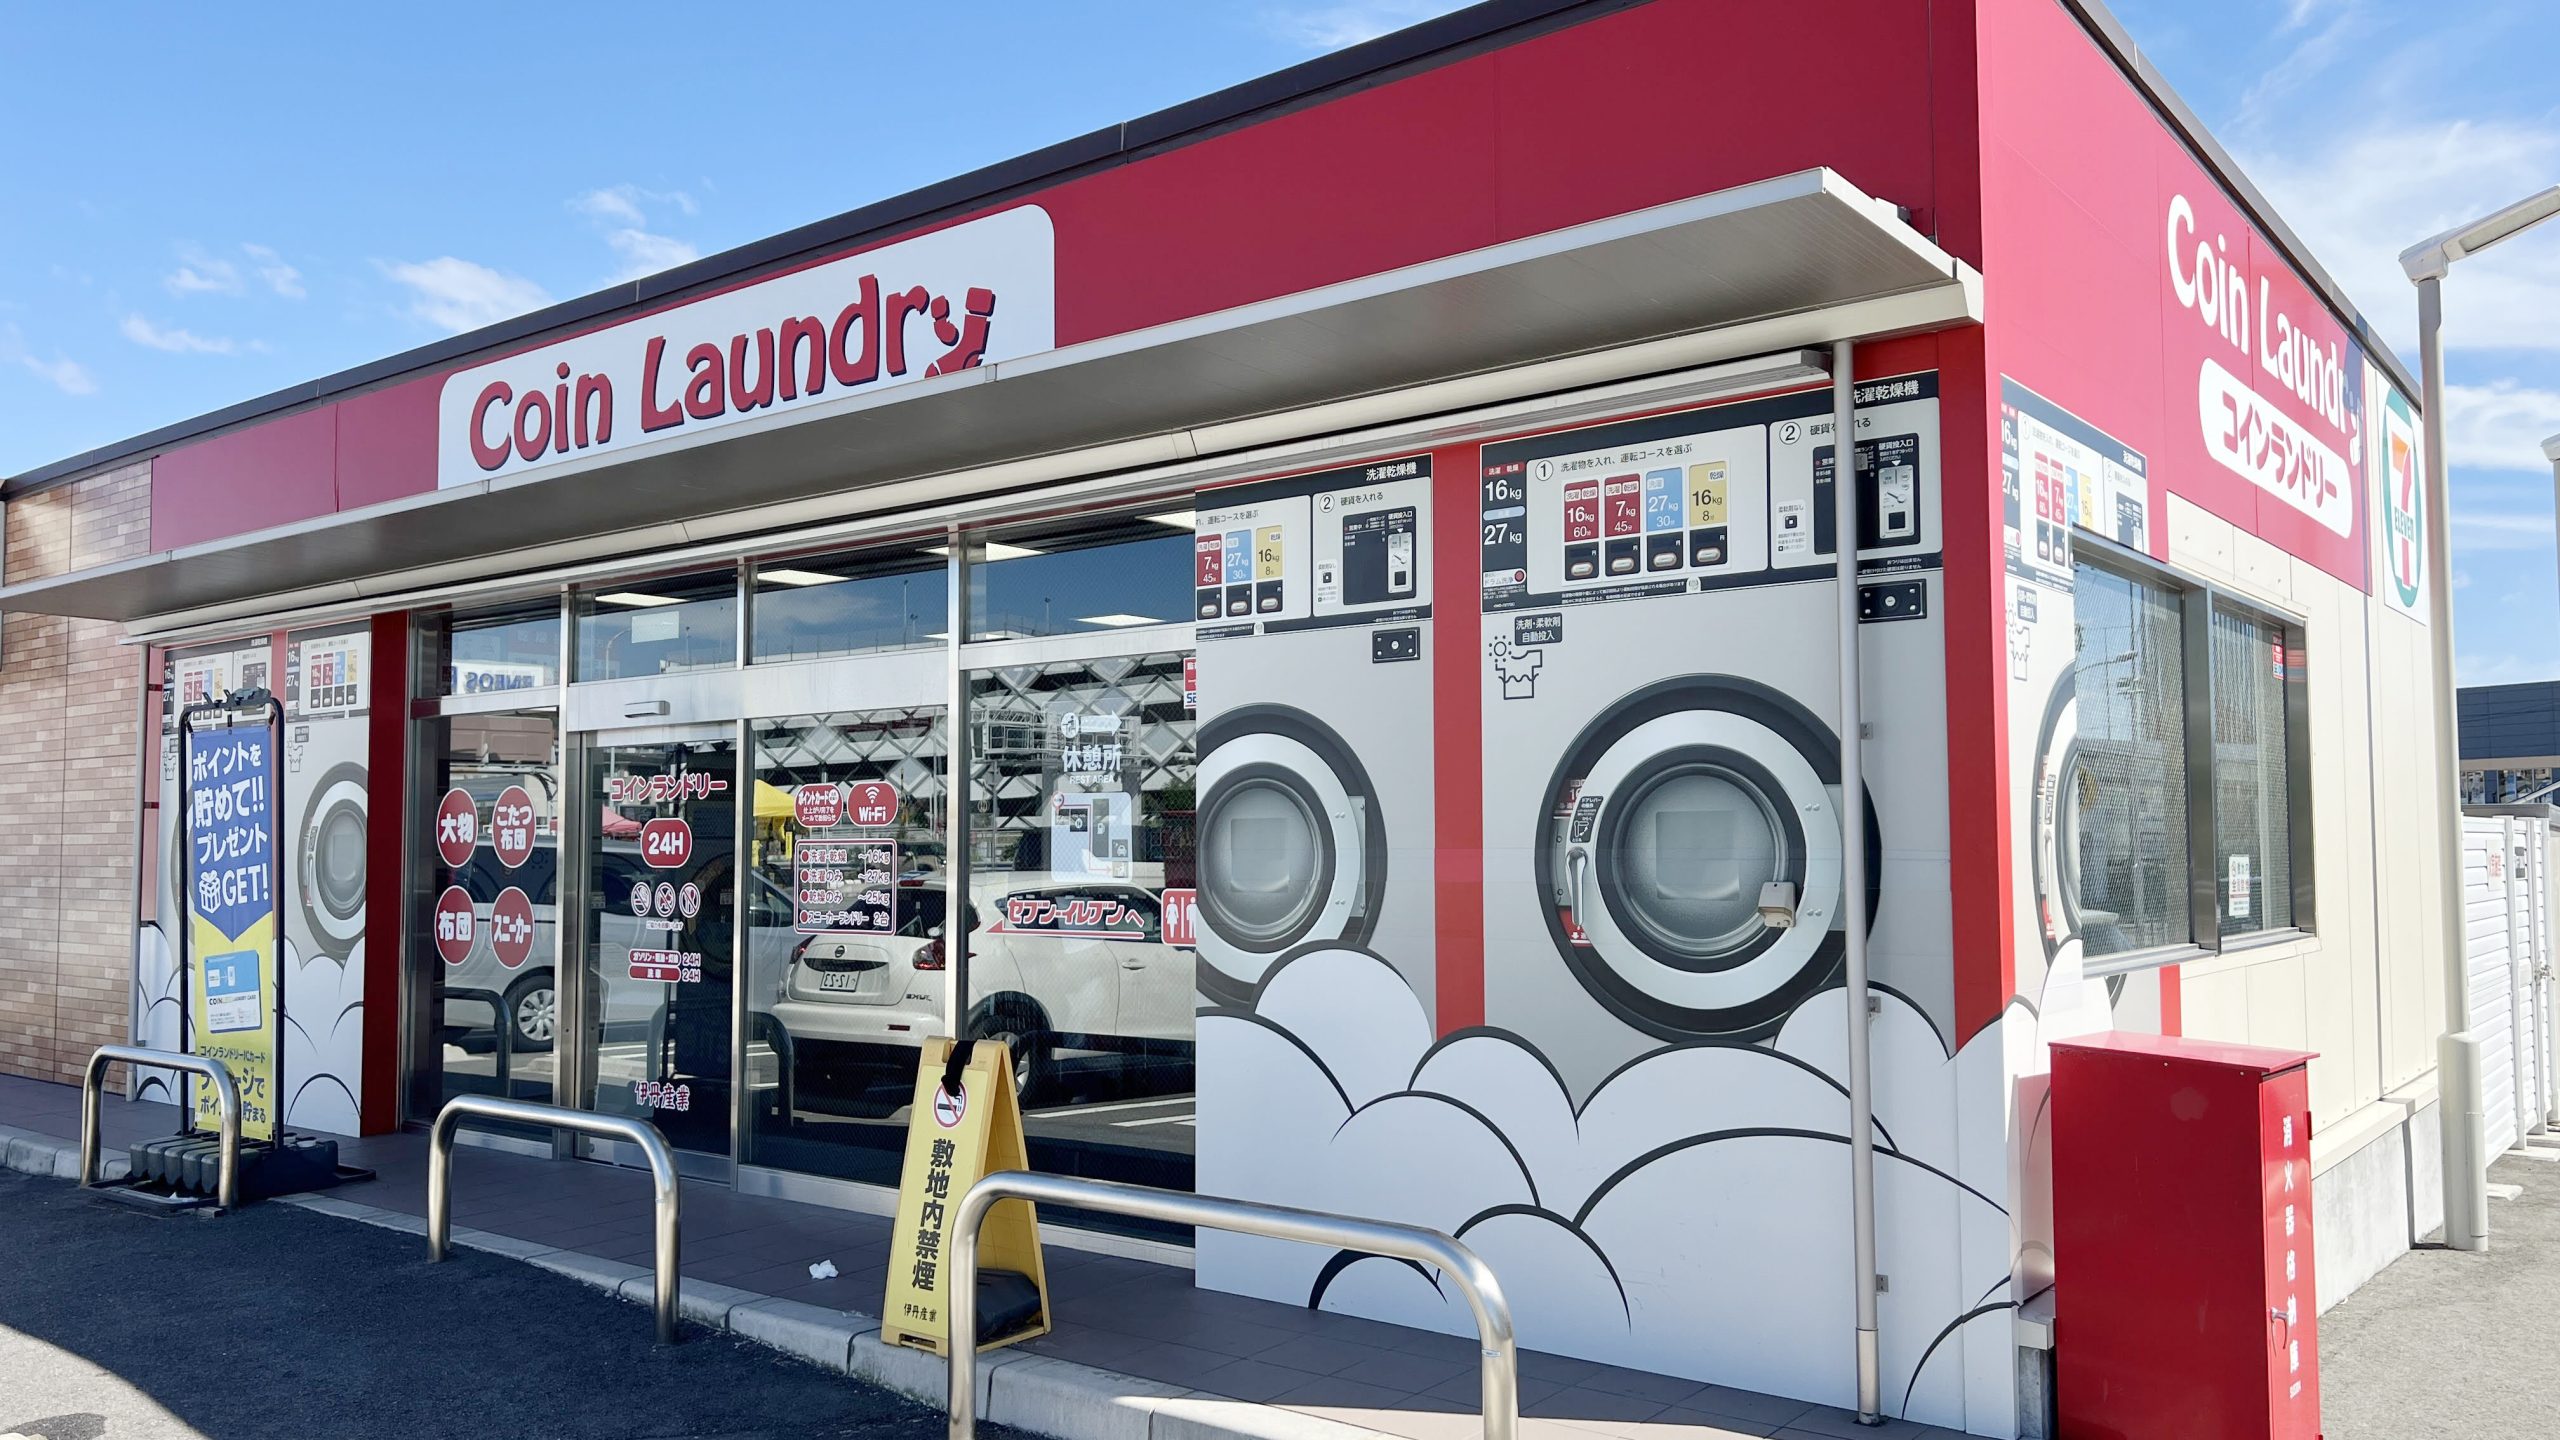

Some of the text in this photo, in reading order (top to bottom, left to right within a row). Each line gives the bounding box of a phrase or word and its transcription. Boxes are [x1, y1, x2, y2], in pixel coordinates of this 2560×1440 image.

[2168, 194, 2363, 467] Coin Laundry
[470, 273, 995, 471] Coin Laundry
[2222, 390, 2338, 509] コインランドリー
[1366, 462, 1417, 481] 洗濯乾燥機
[1340, 491, 1383, 507] 硬貨を入れる
[1648, 495, 1679, 513] 27kg
[1692, 489, 1723, 507] 16kg
[1567, 506, 1595, 523] 16kg
[1616, 501, 1636, 517] 7kg
[1204, 556, 1219, 570] 7kg
[1227, 552, 1249, 567] 27kg
[1521, 629, 1555, 643] 自動投入
[193, 741, 262, 782] ポイントを
[1062, 744, 1122, 772] 休憩所
[611, 772, 727, 802] コインランドリー
[1070, 774, 1115, 784] REST AREA
[496, 804, 533, 827] こたつ
[858, 806, 887, 822] Wi-Fi
[440, 812, 475, 844] 大物
[197, 822, 268, 865] プレゼント
[500, 828, 527, 851] 布団
[648, 831, 684, 855] 24H
[222, 863, 269, 907] GET!
[808, 869, 843, 884] 洗濯のみ
[808, 889, 843, 904] 乾燥のみ
[438, 910, 473, 942] 布団
[493, 912, 532, 944] スニーカー
[808, 911, 890, 926] スニーカーランドリー 2台
[682, 952, 701, 967] 24H
[682, 968, 701, 983] 24H
[200, 1045, 266, 1064] コインランドリーICカード
[634, 1080, 690, 1112] 伊丹産業
[911, 1138, 956, 1291] 敷地内禁煙
[903, 1303, 937, 1323] 伊丹産業
